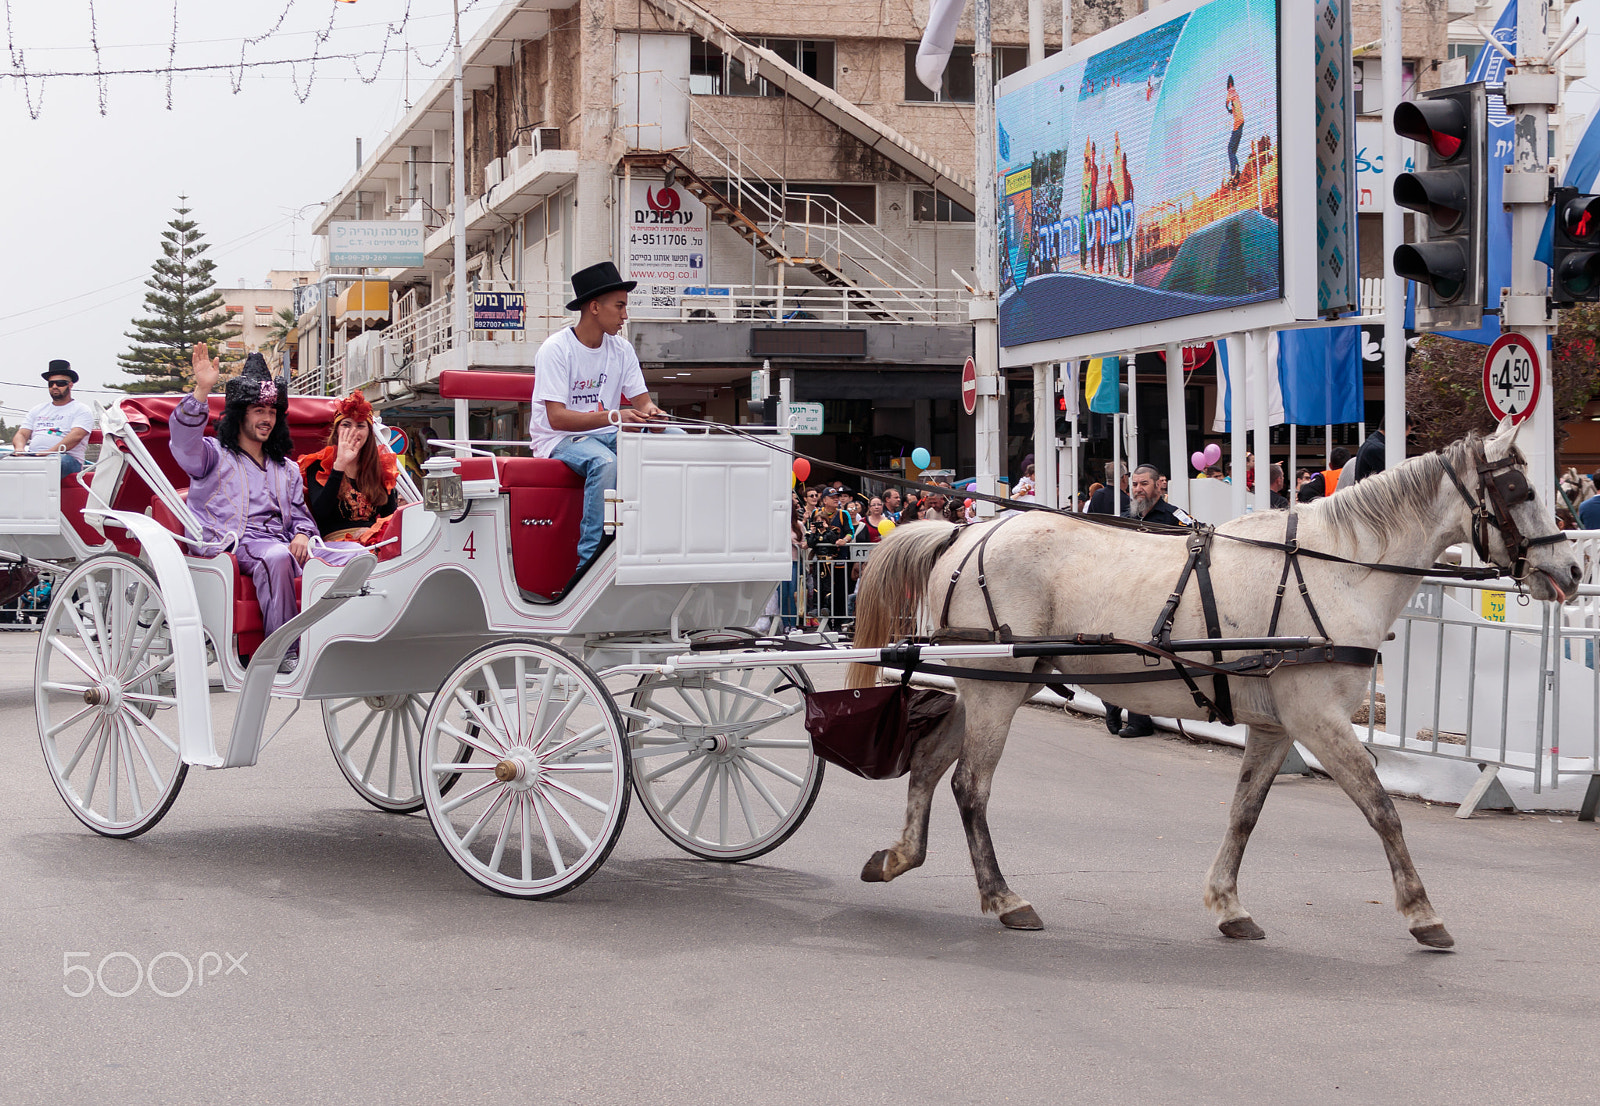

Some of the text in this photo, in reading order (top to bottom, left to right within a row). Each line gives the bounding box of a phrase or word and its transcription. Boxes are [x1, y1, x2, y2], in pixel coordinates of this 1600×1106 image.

[634, 210, 693, 225] ערבובים
[349, 227, 378, 237] נהריה
[381, 227, 418, 237] פנורמה
[1039, 200, 1135, 262] ספורט נהריה
[630, 233, 687, 246] 4-9511706
[653, 254, 670, 262] אותנו
[671, 254, 688, 262] חפשו
[630, 270, 698, 281] www.vog.co.il
[474, 294, 524, 310] תיווך ברוש
[462, 530, 477, 560] 4
